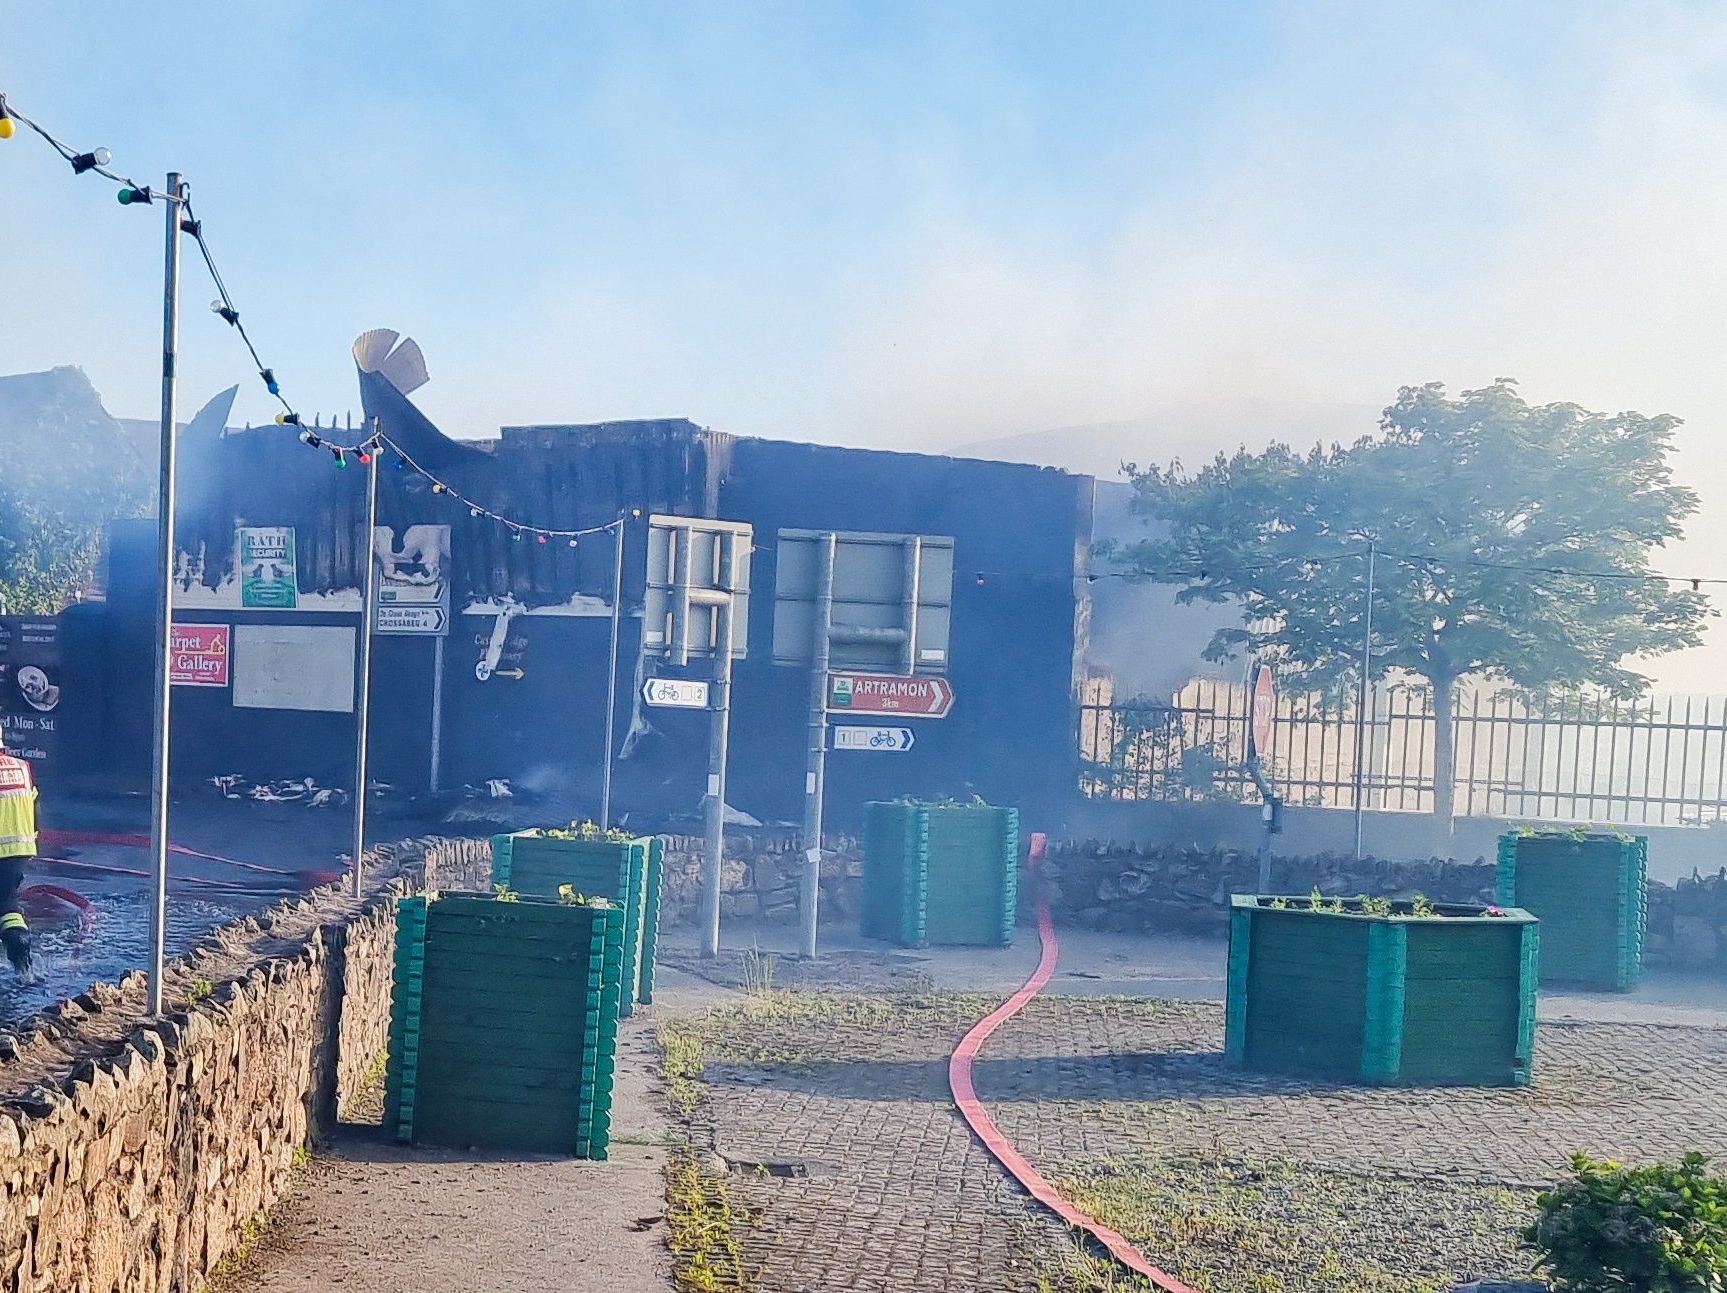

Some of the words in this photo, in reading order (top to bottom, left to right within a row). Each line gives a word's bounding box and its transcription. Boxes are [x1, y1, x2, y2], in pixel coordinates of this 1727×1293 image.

[247, 535, 286, 547] RATH
[177, 654, 223, 675] Gallery
[696, 688, 703, 699] 2
[854, 680, 928, 697] ARTRAMON
[881, 698, 899, 708] 3km
